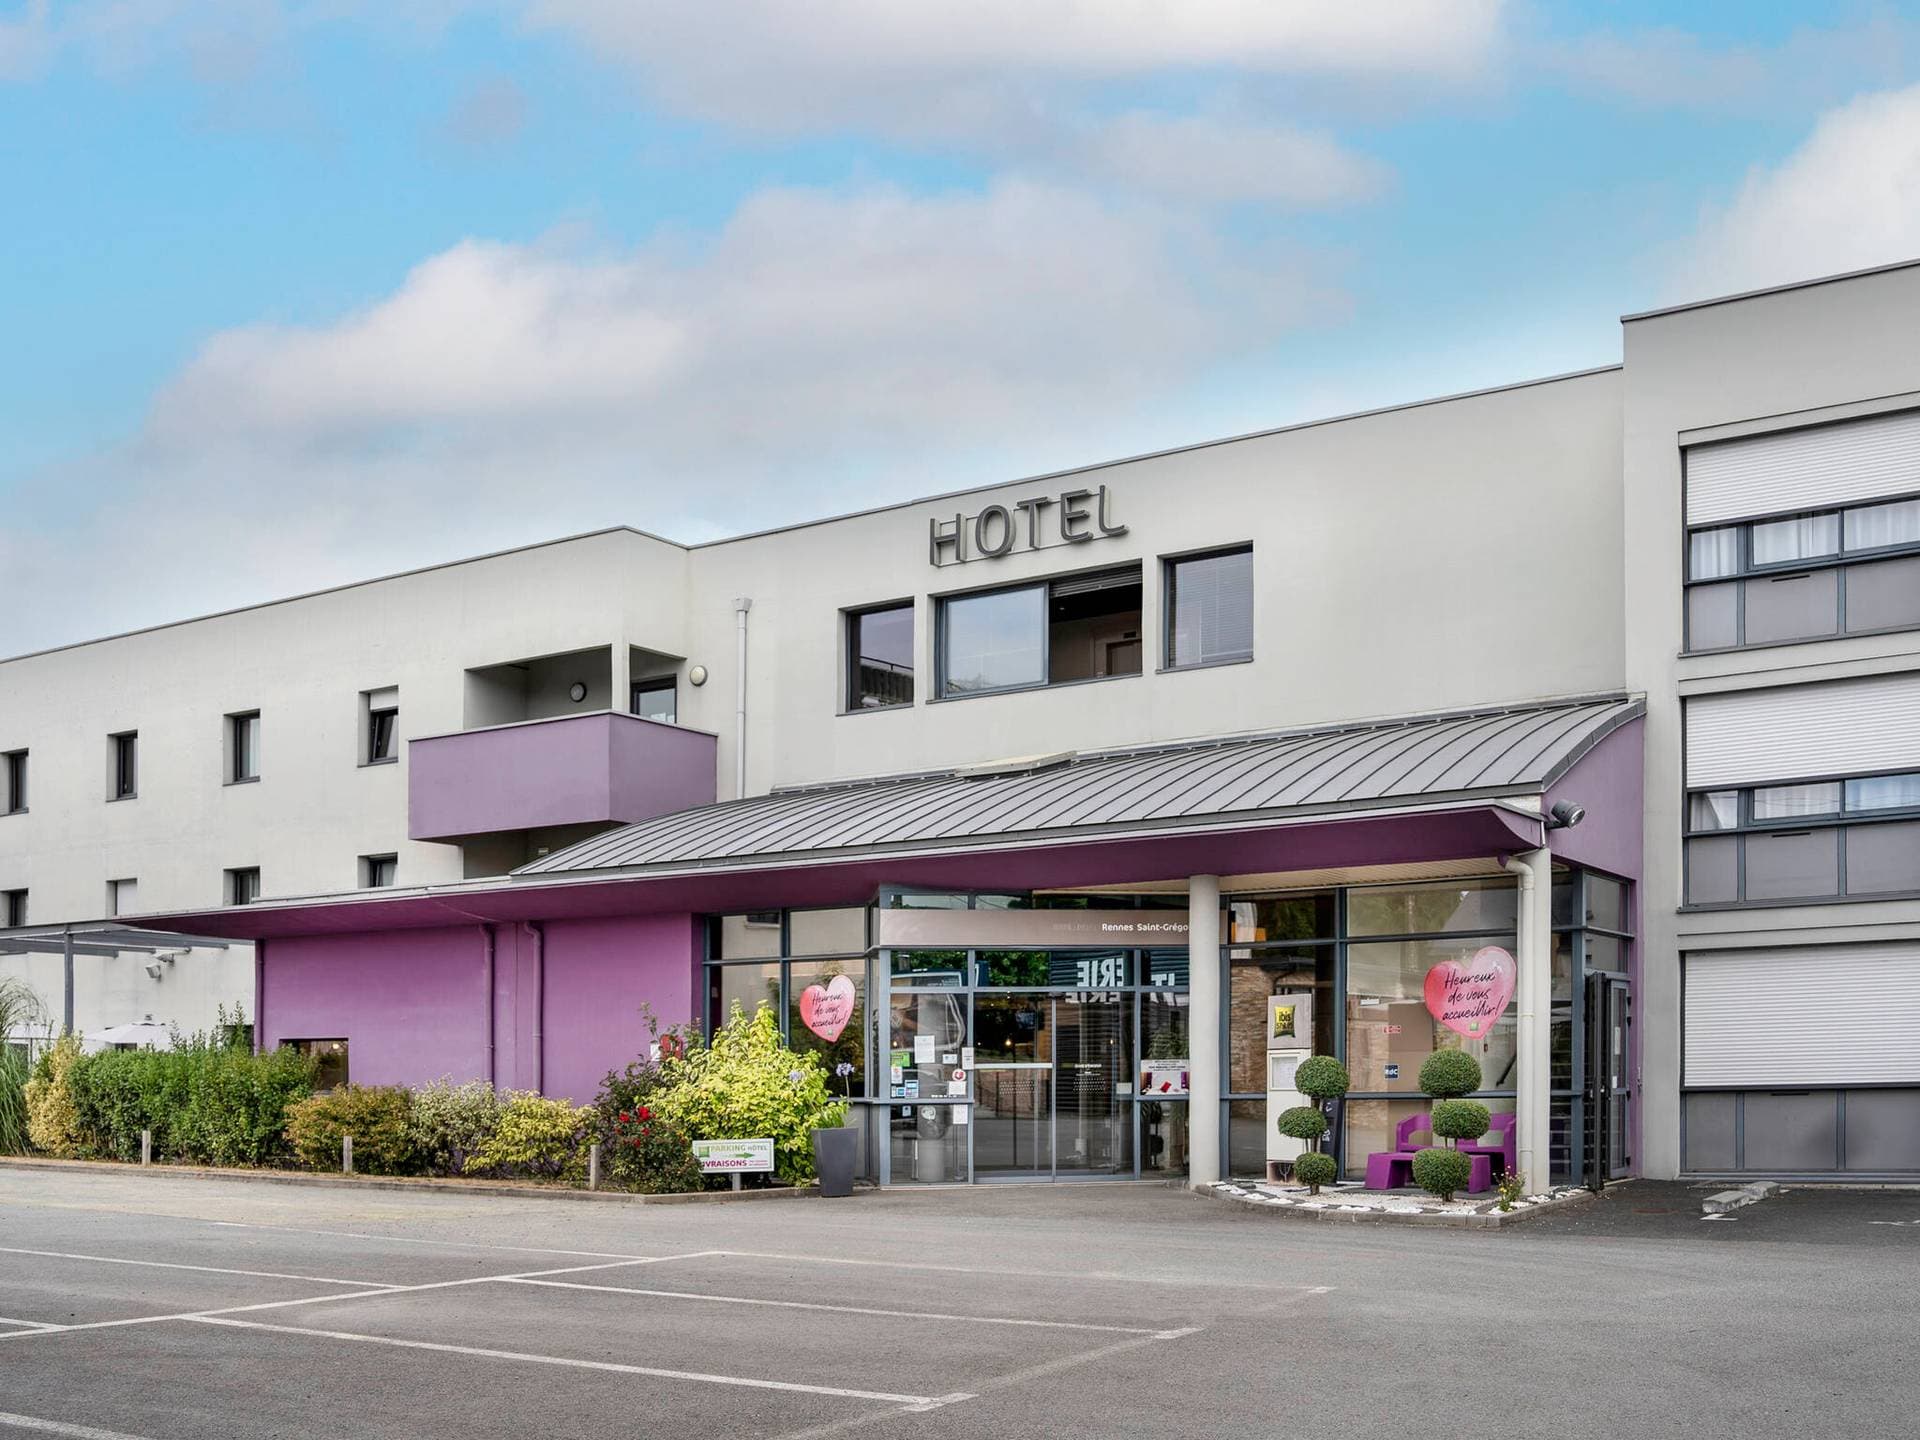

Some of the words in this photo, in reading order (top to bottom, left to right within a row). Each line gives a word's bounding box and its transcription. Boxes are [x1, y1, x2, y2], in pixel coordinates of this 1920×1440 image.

[930, 485, 1128, 565] HOTEL
[1102, 923, 1133, 931] Rennes
[1444, 968, 1496, 989] Heureux
[1448, 987, 1463, 1005] de
[1466, 988, 1491, 1000] vous
[711, 1144, 746, 1152] PARKING
[703, 1159, 747, 1167] IVRAISONS
